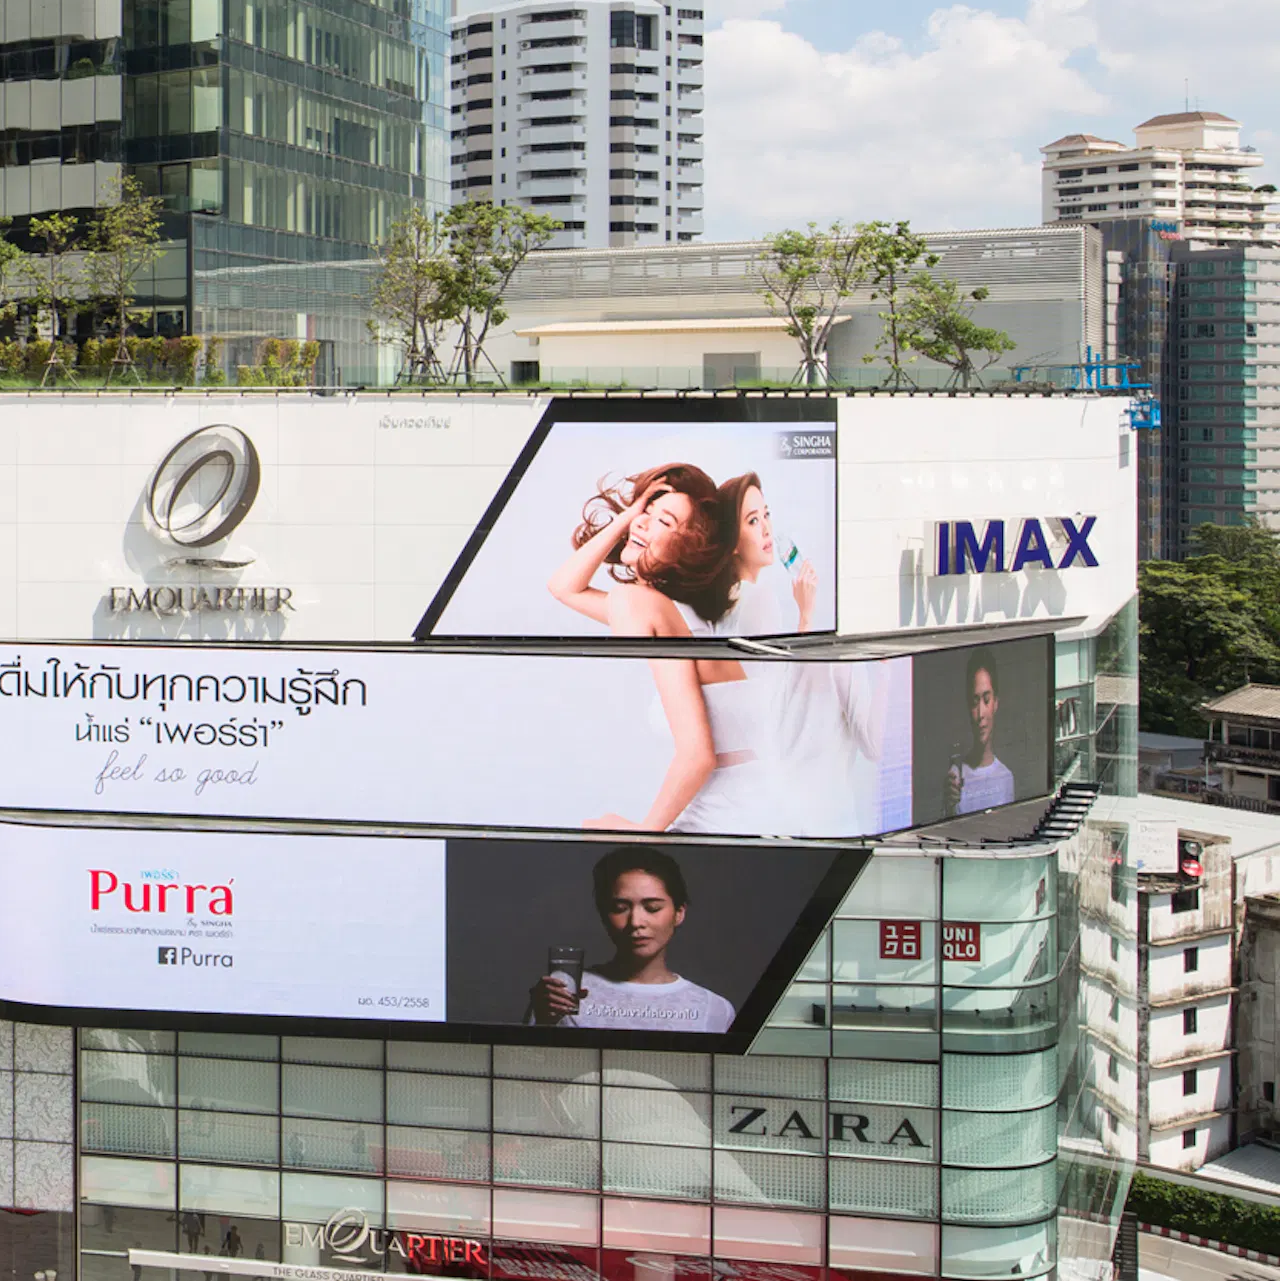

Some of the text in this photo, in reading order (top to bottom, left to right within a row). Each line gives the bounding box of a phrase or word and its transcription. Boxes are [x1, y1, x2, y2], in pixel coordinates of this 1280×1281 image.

[793, 435, 831, 448] SINGHA
[935, 515, 1100, 576] IMAX
[109, 586, 297, 616] EMQUARTIER
[74, 712, 131, 743] น้ำแร่
[95, 749, 260, 797] feel so good
[942, 927, 974, 942] UNI
[180, 946, 234, 968] Purra
[942, 942, 977, 960] QLO
[378, 996, 431, 1009] 453/2558
[728, 1105, 931, 1149] ZARA
[283, 1206, 489, 1264] EMQUARTIER
[272, 1266, 292, 1277] THE
[294, 1268, 330, 1281] GLASS
